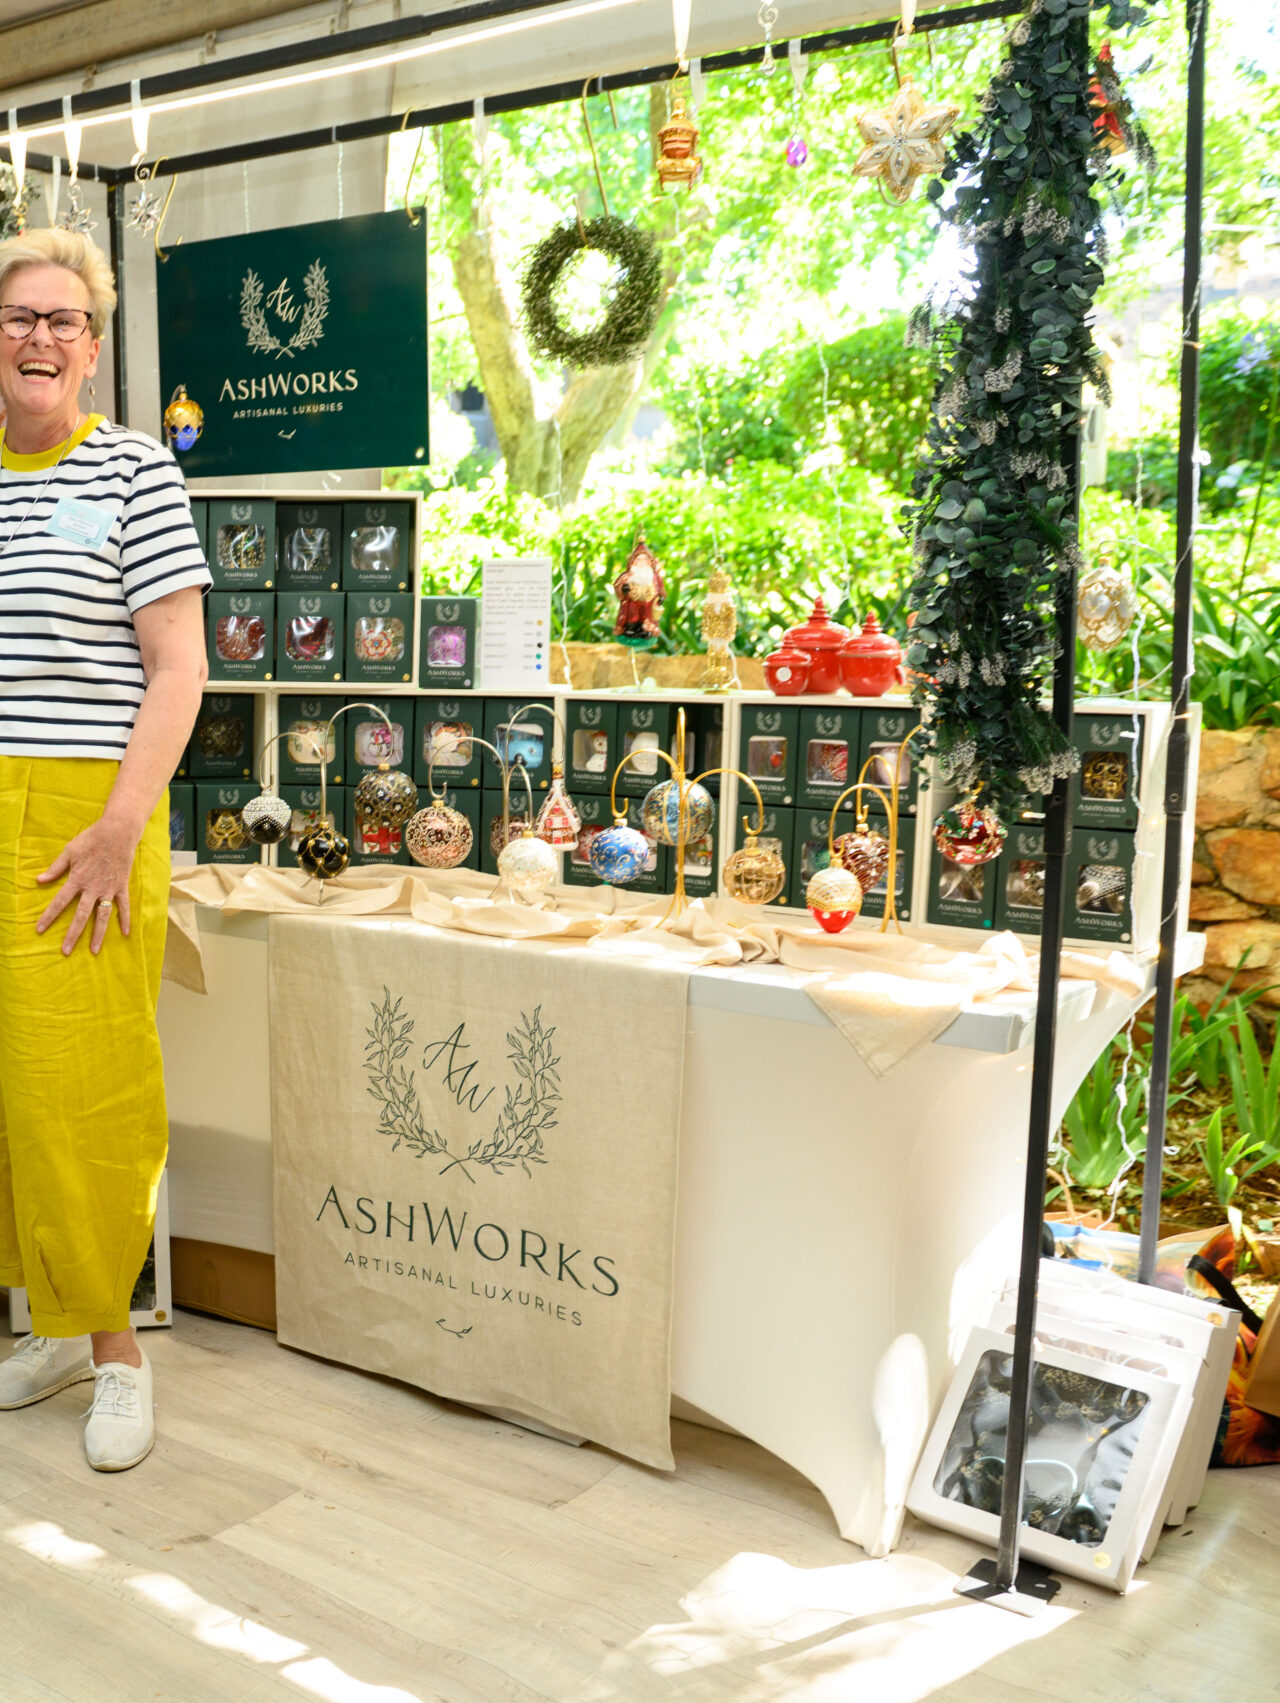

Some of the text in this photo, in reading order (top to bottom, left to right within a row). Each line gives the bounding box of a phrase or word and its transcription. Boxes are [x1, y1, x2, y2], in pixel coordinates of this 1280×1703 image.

[218, 369, 359, 402] ASHWORKS
[233, 402, 343, 419] ARTISANAL LUXURIES
[1078, 804, 1127, 813] ASHWORKS
[938, 904, 983, 914] ASHWORKS
[1074, 917, 1124, 927] ASHWORKS
[315, 1184, 620, 1297] ASHWORKS
[344, 1252, 583, 1327] ARTISANAL LUXURIES
